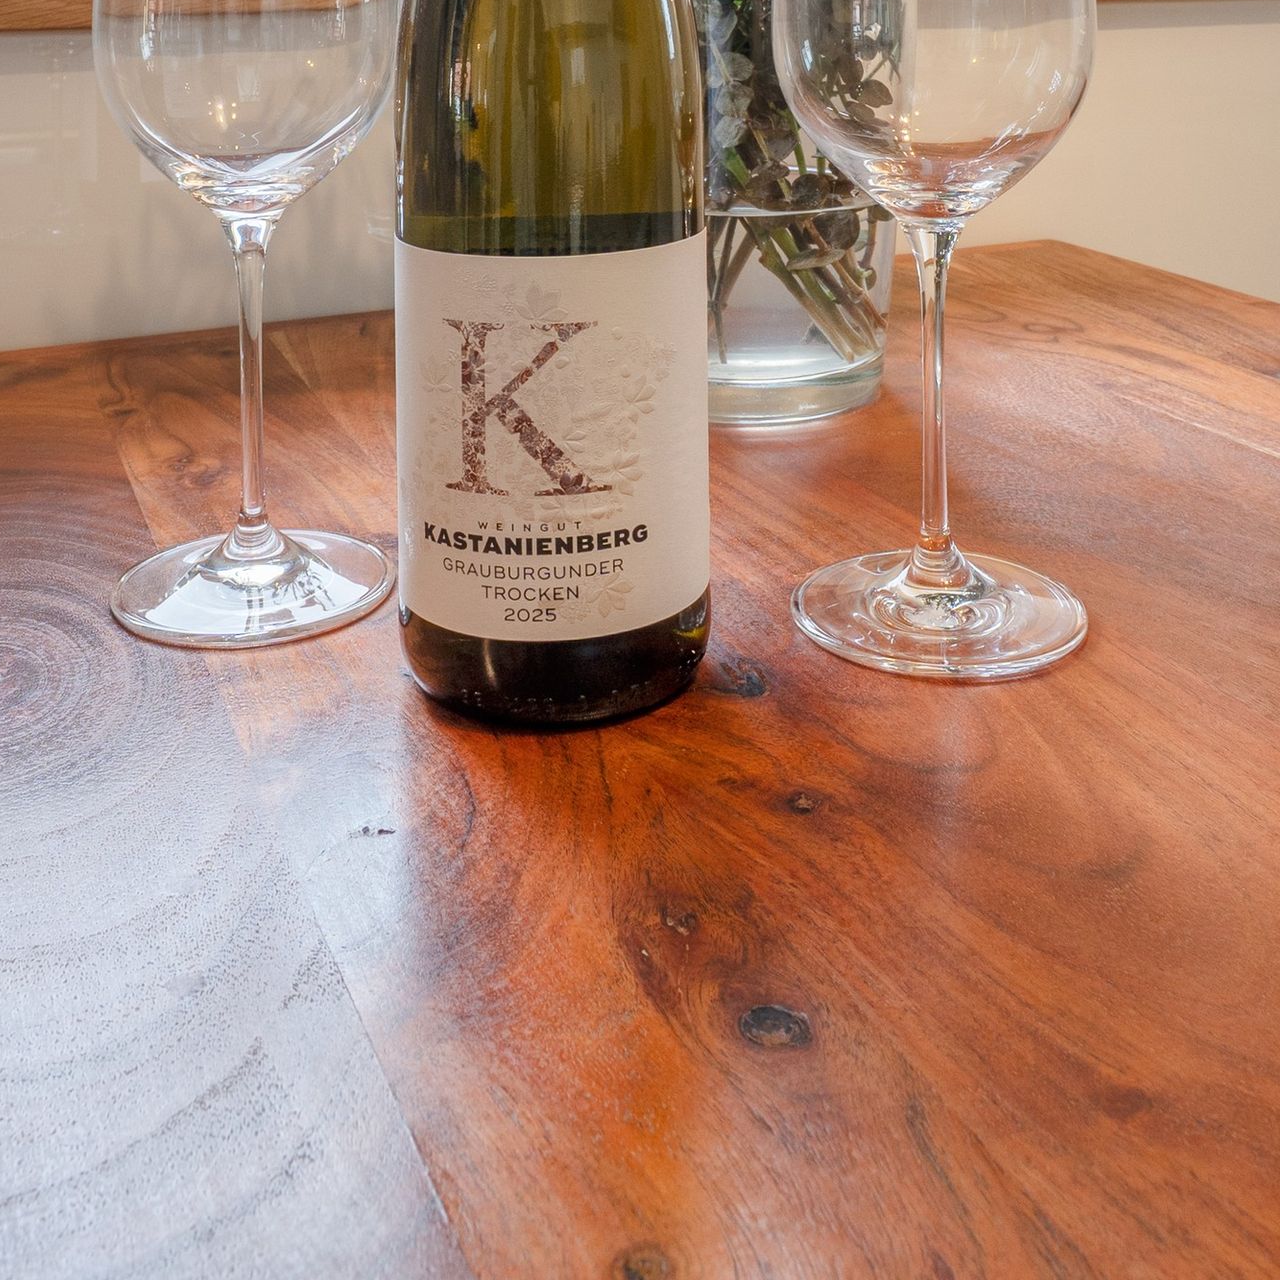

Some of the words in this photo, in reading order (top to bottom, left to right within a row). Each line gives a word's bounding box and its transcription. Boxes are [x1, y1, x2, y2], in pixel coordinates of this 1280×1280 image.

[442, 318, 613, 496] K
[478, 521, 582, 532] WEINGUT
[424, 521, 648, 556] KASTANIENBERG
[443, 557, 624, 580] GRAUBURGUNDER
[481, 585, 579, 601] TROCKEN
[504, 608, 557, 622] 2025
